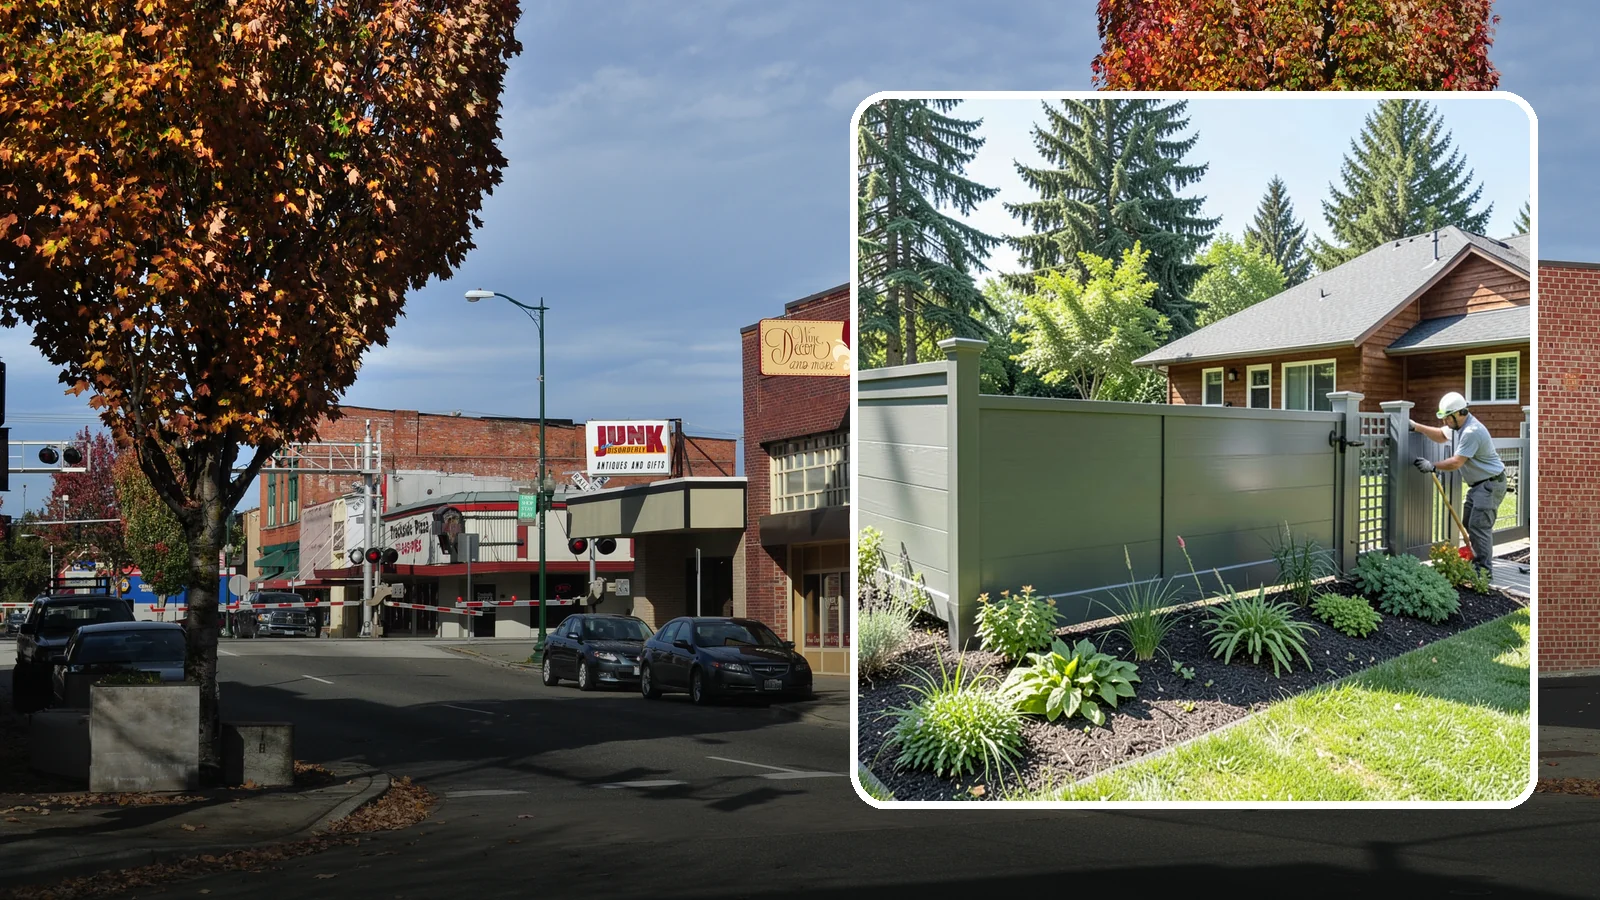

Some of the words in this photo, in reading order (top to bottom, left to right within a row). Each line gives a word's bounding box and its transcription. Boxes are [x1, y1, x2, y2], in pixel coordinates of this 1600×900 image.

[765, 327, 830, 365] Decor
[596, 425, 665, 457] JUNK
[607, 446, 646, 454] DISORDERLY
[597, 461, 628, 470] ANTIQUES
[631, 461, 644, 469] AND
[647, 460, 665, 469] GIFTS
[390, 521, 413, 539] Trackside
[415, 519, 429, 534] Pizza
